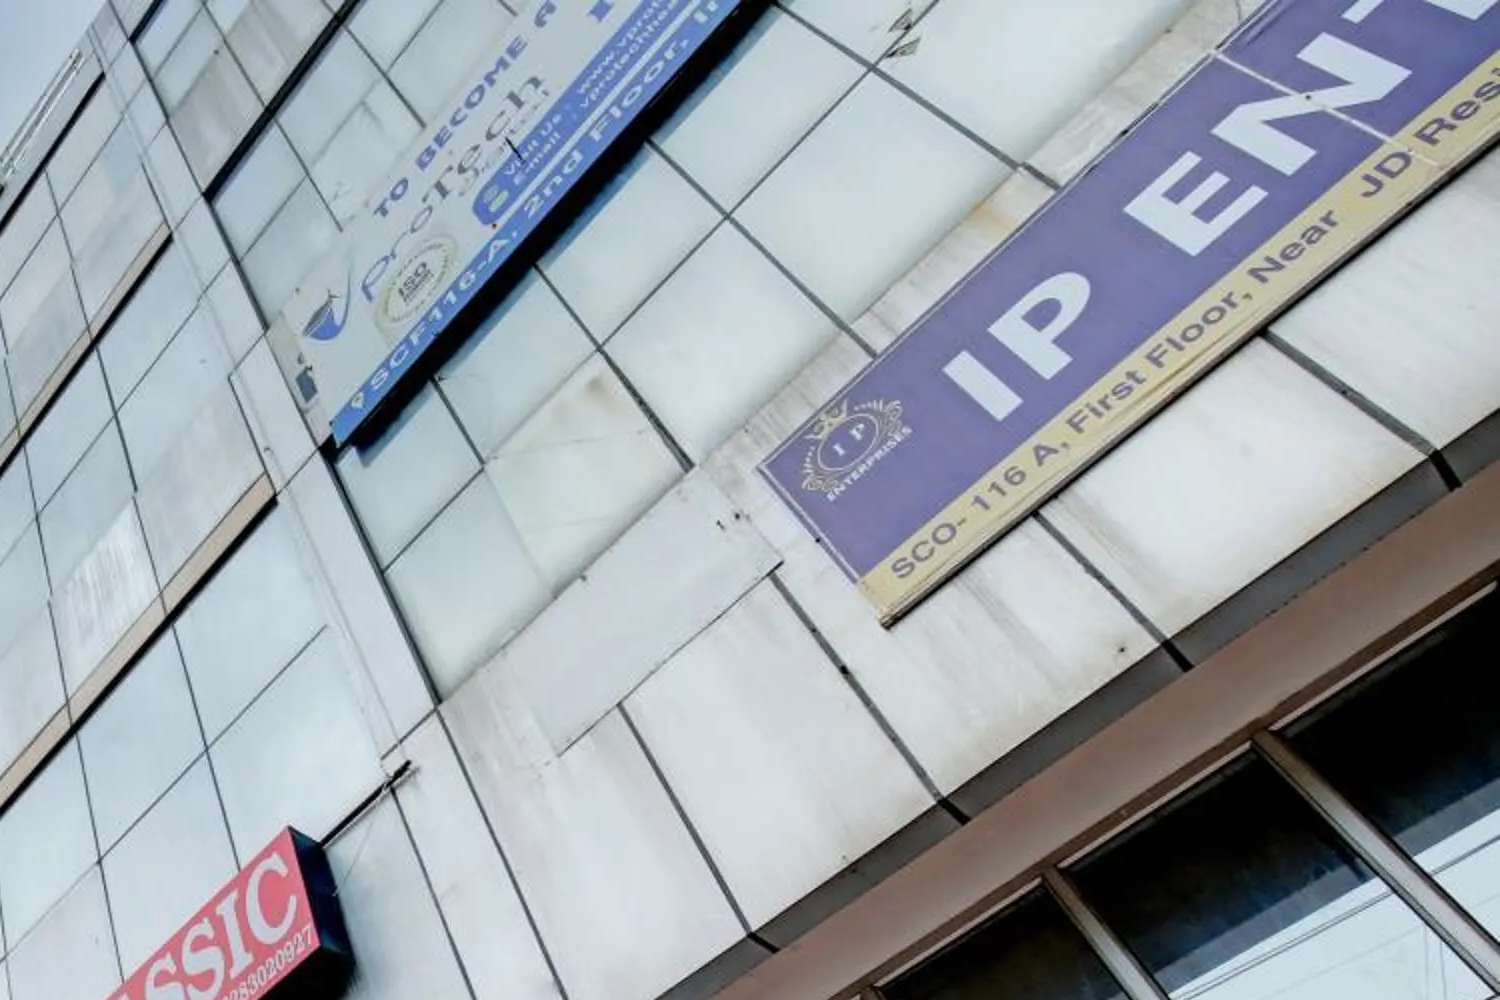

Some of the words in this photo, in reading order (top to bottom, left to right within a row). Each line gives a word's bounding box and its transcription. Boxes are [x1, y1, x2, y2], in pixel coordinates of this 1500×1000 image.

[373, 178, 408, 217] TO
[415, 35, 528, 171] BECOME
[523, 149, 583, 218] 2nd
[589, 39, 688, 141] Floor,
[891, 517, 966, 578] SCO-
[972, 466, 1027, 511] 116
[1066, 368, 1146, 433] First
[1144, 291, 1253, 369] Floor,
[1246, 209, 1339, 283] Near
[1361, 150, 1413, 198] JD
[1413, 67, 1500, 146] Res
[942, 271, 1091, 420] IP
